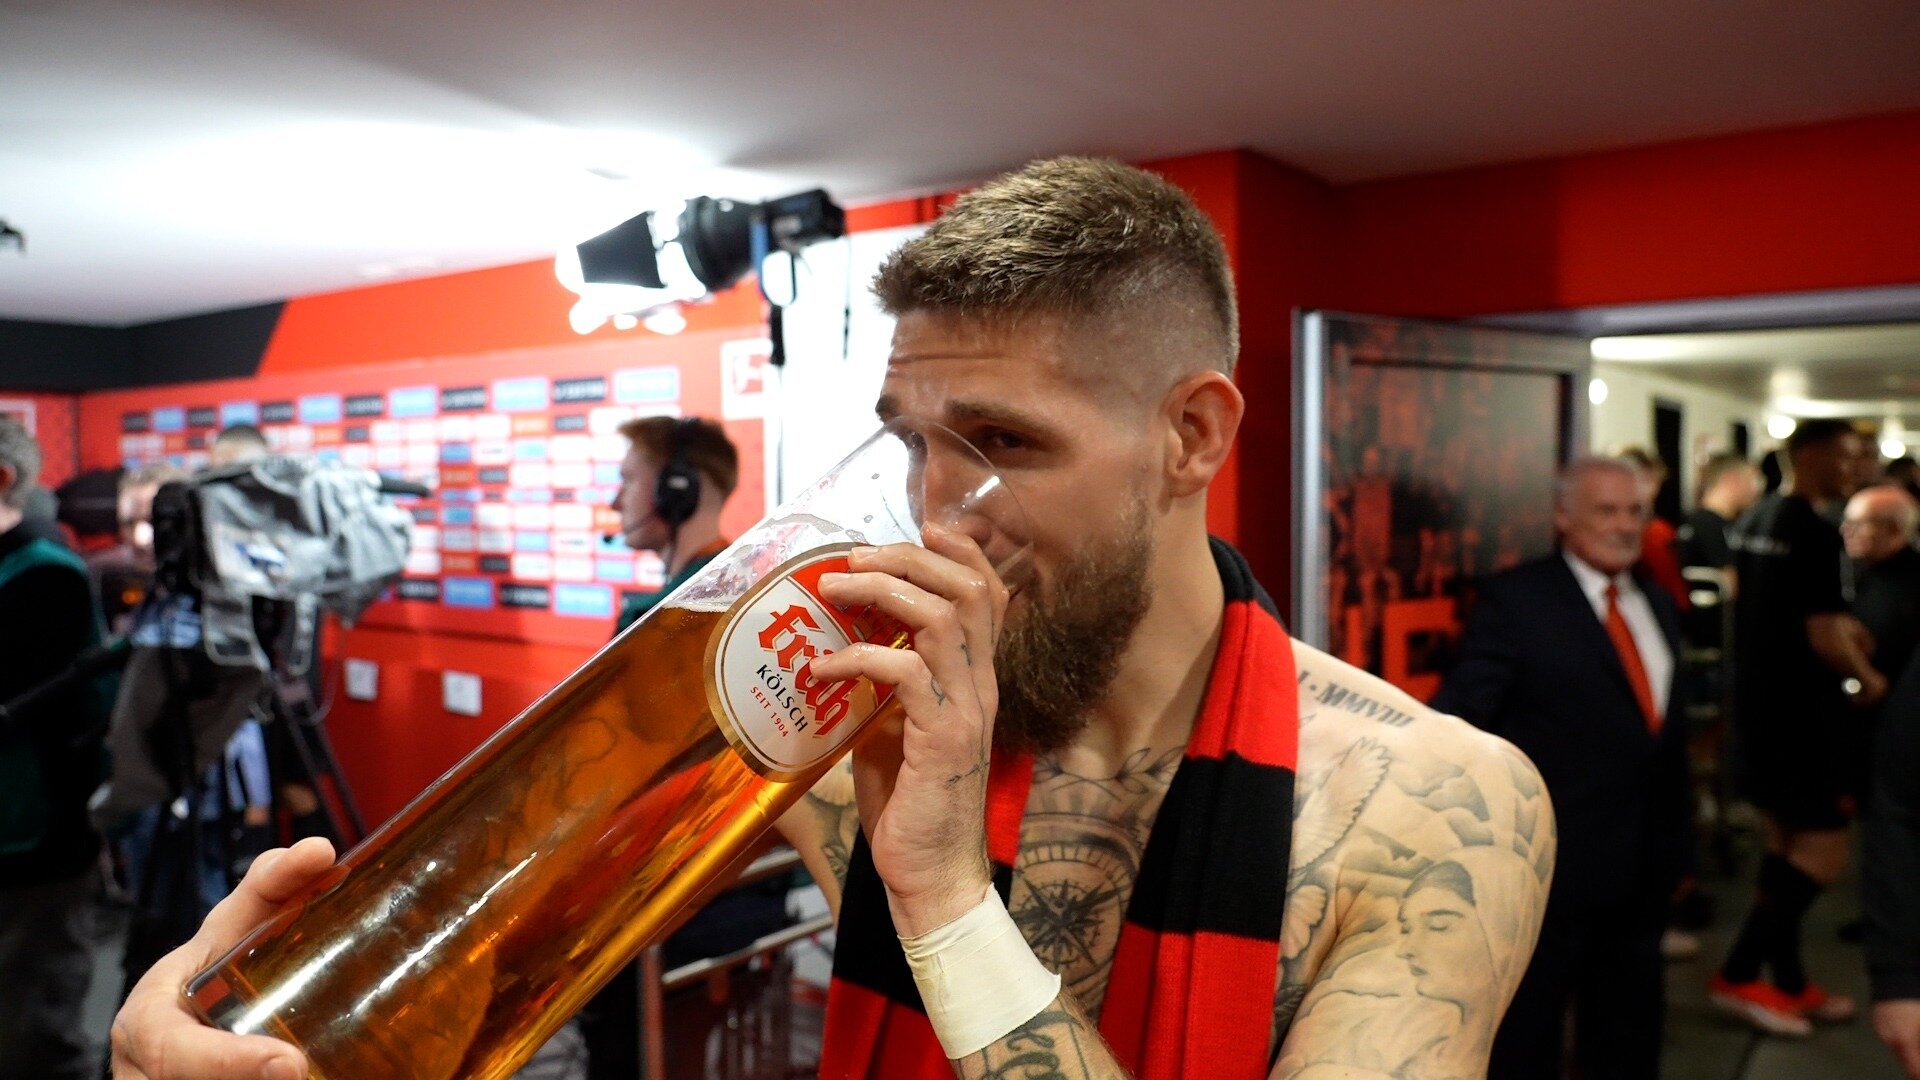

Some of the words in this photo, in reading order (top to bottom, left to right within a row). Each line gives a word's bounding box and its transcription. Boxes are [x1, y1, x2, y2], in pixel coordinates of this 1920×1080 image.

[750, 686, 771, 711] SEIT
[770, 712, 789, 738] 1904
[756, 664, 808, 733] KÖLSCH
